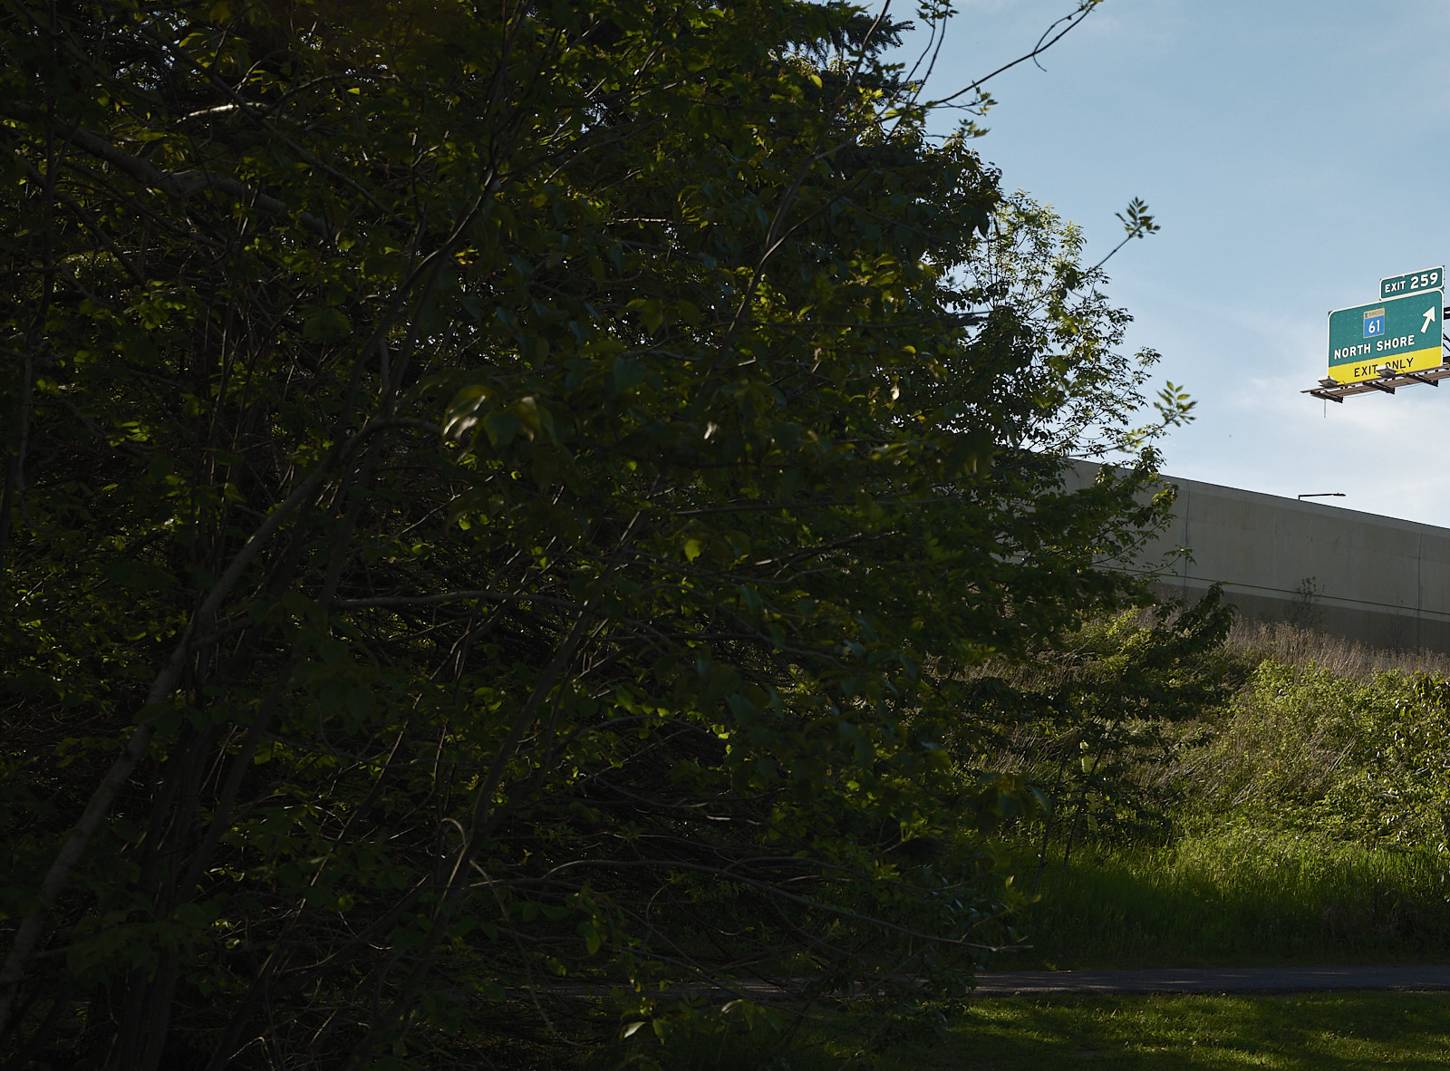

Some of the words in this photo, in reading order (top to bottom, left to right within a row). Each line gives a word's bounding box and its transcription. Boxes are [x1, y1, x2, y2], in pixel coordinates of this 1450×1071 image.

[1384, 281, 1406, 293] EXIT
[1410, 272, 1438, 289] 259
[1368, 319, 1380, 334] 61
[1334, 343, 1371, 359] NORTH
[1376, 335, 1415, 351] SHORE
[1354, 364, 1378, 377] EXIT
